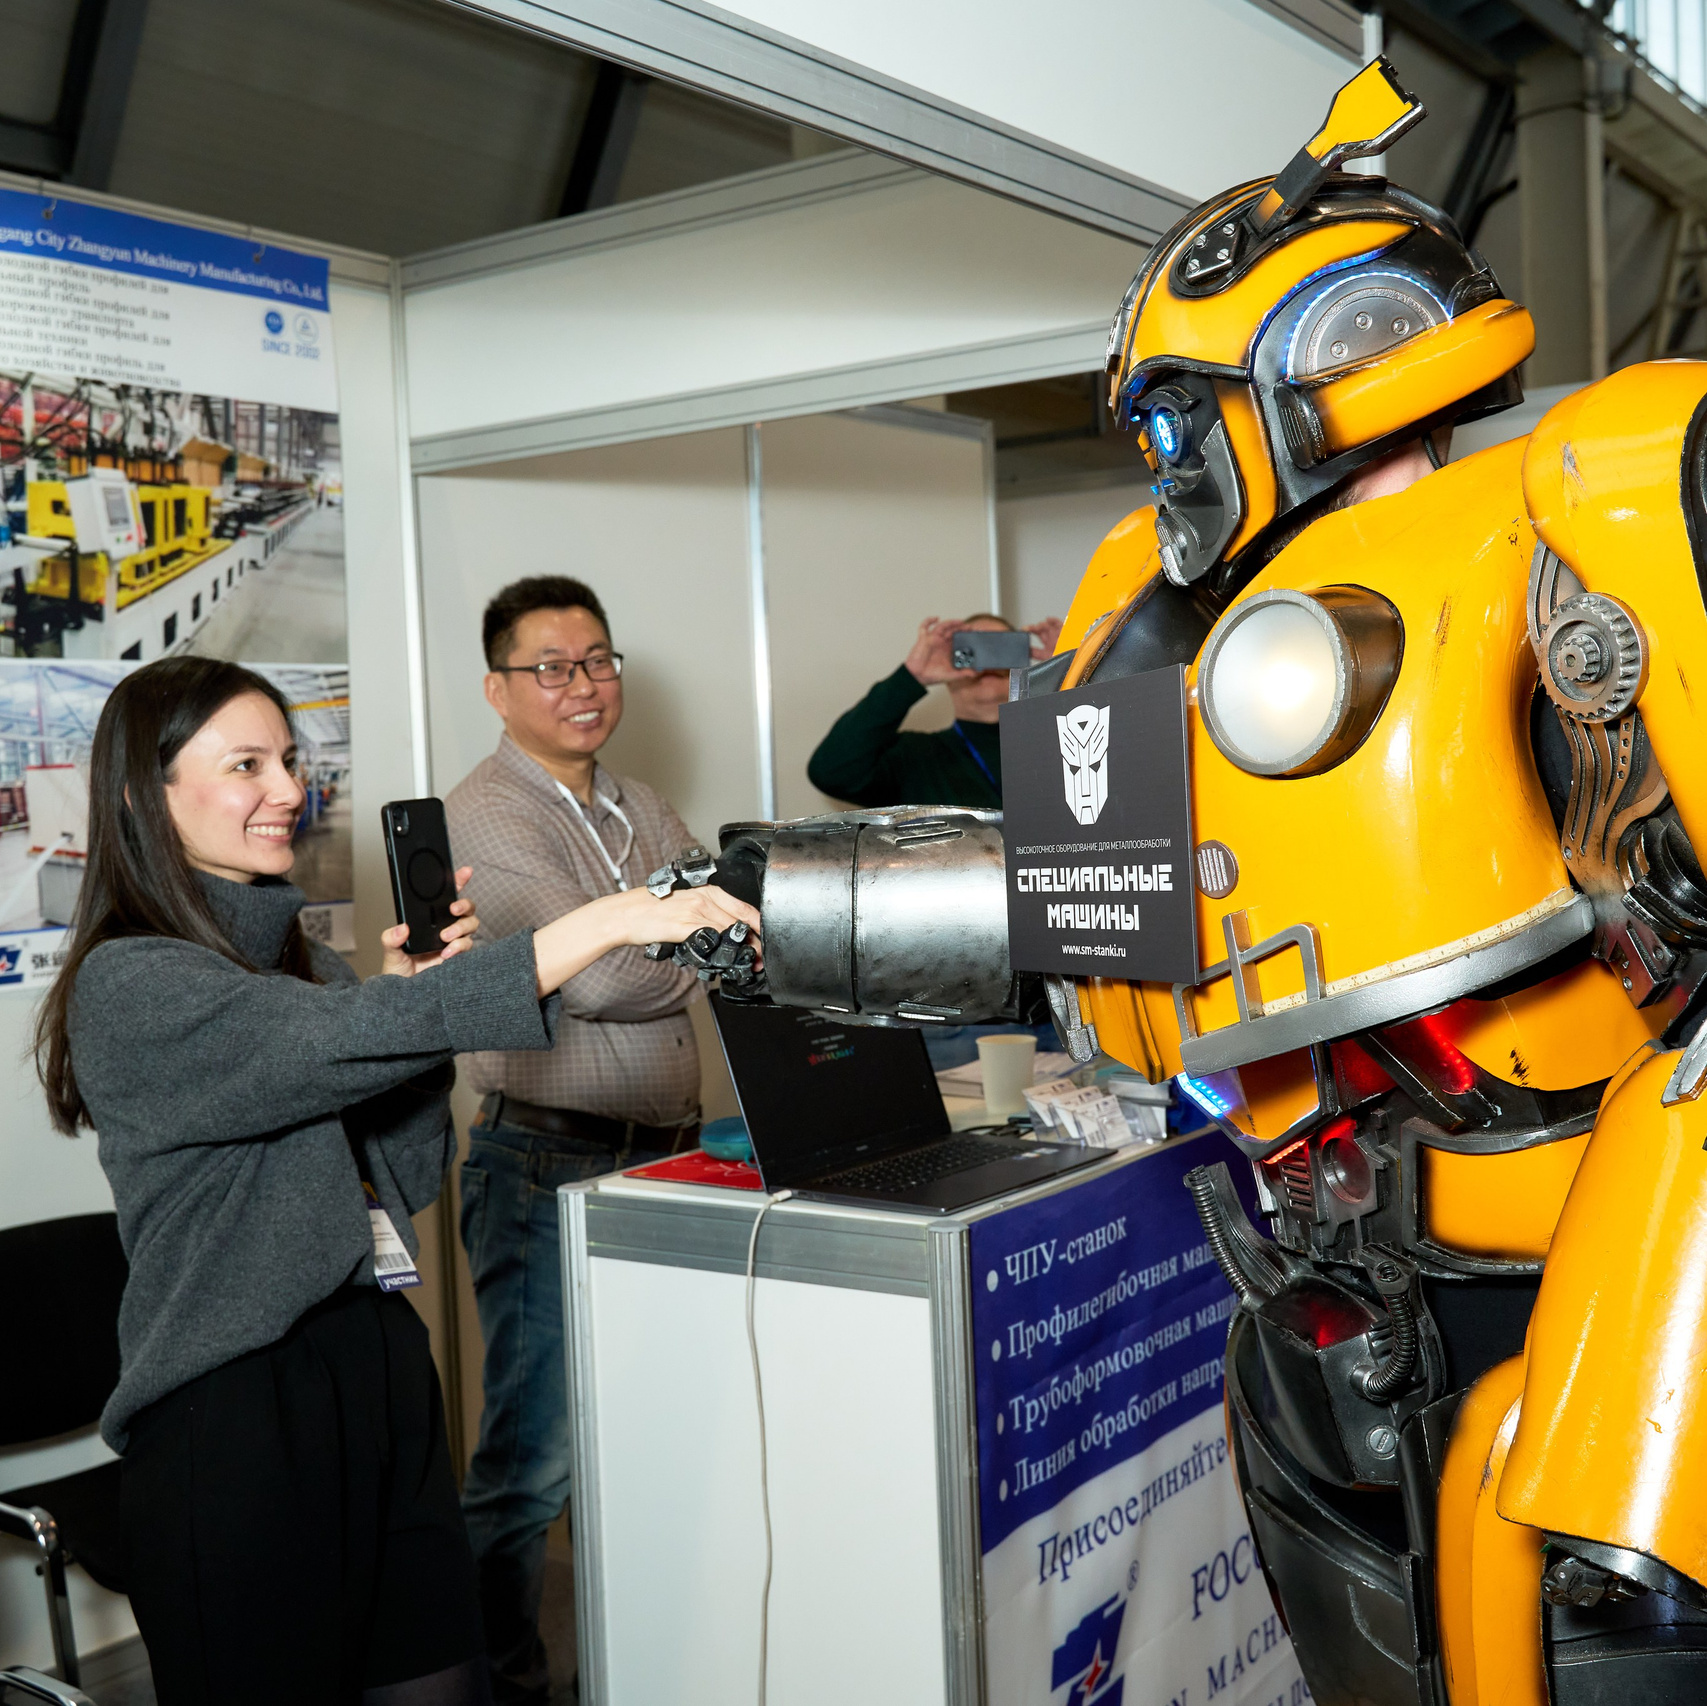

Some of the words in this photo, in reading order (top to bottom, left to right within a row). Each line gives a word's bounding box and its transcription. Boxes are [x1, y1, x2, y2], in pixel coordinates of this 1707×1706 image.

[35, 228, 66, 252] City
[133, 247, 198, 278] Machinery
[199, 261, 283, 295] Manufacturing
[151, 282, 169, 295] для
[1016, 843, 1055, 855] ВЫСОКОТОЧНОЕ
[1055, 841, 1098, 854] ОБОРУДОВАНИЕ
[1098, 841, 1110, 852] ДЛЯ
[1110, 838, 1171, 851] МЕТАЛЛООБРАБОТКИ
[1017, 864, 1173, 892] СПЕЦИАЛЬНЫЕ
[1047, 903, 1140, 931] МАШИНЫ
[1062, 944, 1126, 957] www.sm-stanki.ru
[1004, 1214, 1128, 1287] ЧПУ-станок
[1007, 1257, 1178, 1360] Профилегибочная
[1009, 1314, 1192, 1433] Трубоформовочная
[1013, 1440, 1076, 1498] Линия
[1079, 1375, 1178, 1450] обработки
[1037, 1435, 1228, 1586] Присоединяйте
